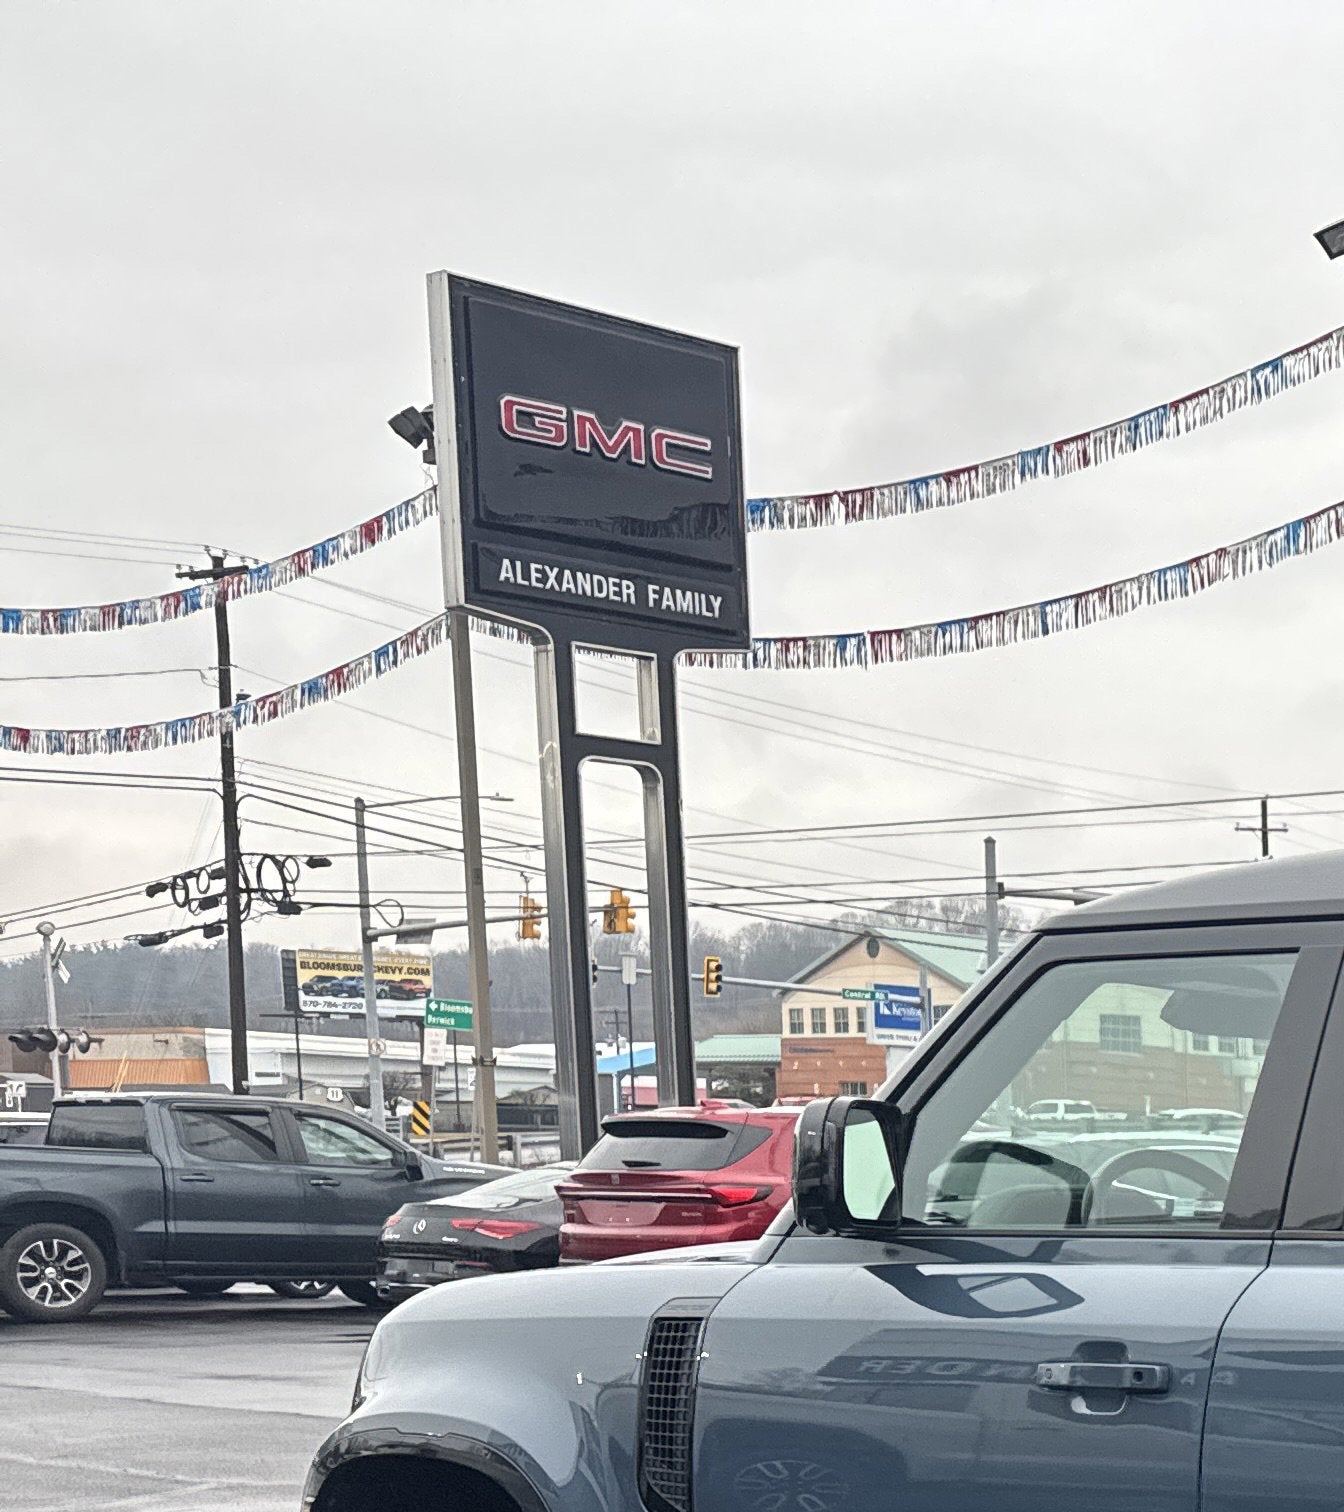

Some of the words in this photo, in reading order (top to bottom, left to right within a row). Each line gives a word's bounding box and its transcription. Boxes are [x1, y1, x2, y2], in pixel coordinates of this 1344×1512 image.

[500, 394, 713, 479] GMC
[499, 557, 636, 606] ALEXANDER
[648, 584, 722, 620] FAMILY
[300, 961, 430, 976] BLOOMSBURCHEVY.COM
[330, 1089, 339, 1099] 11
